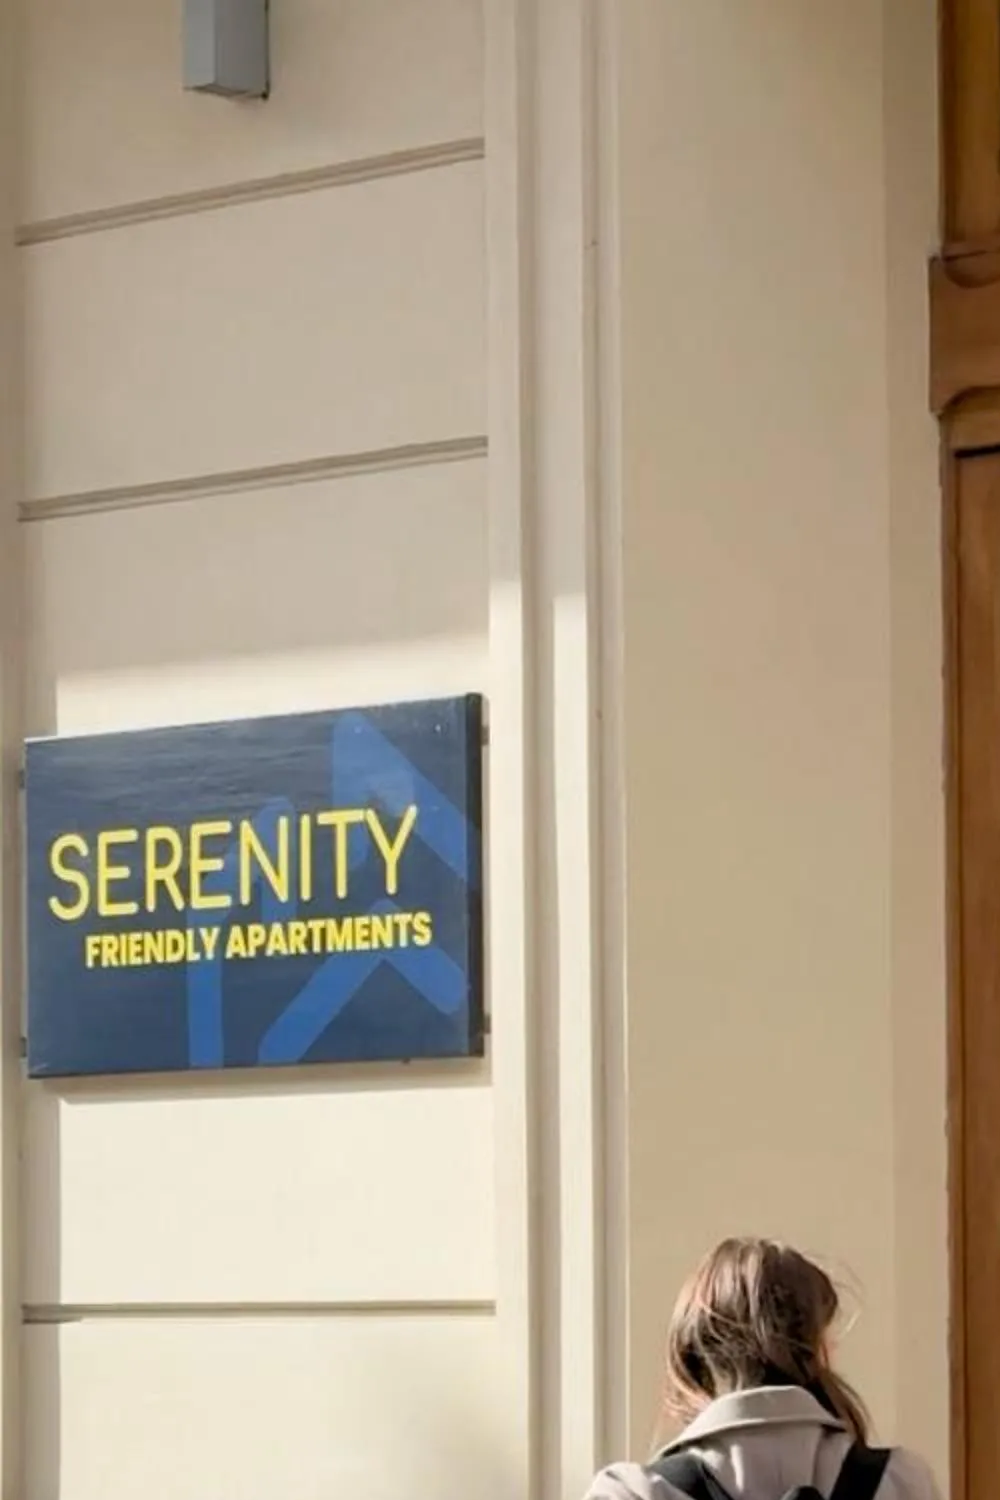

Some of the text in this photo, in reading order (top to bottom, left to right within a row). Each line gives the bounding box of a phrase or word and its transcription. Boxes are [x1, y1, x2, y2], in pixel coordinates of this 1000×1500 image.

[48, 804, 418, 920] SERENITY
[85, 911, 433, 969] FRIENDLY APARTMENTS
